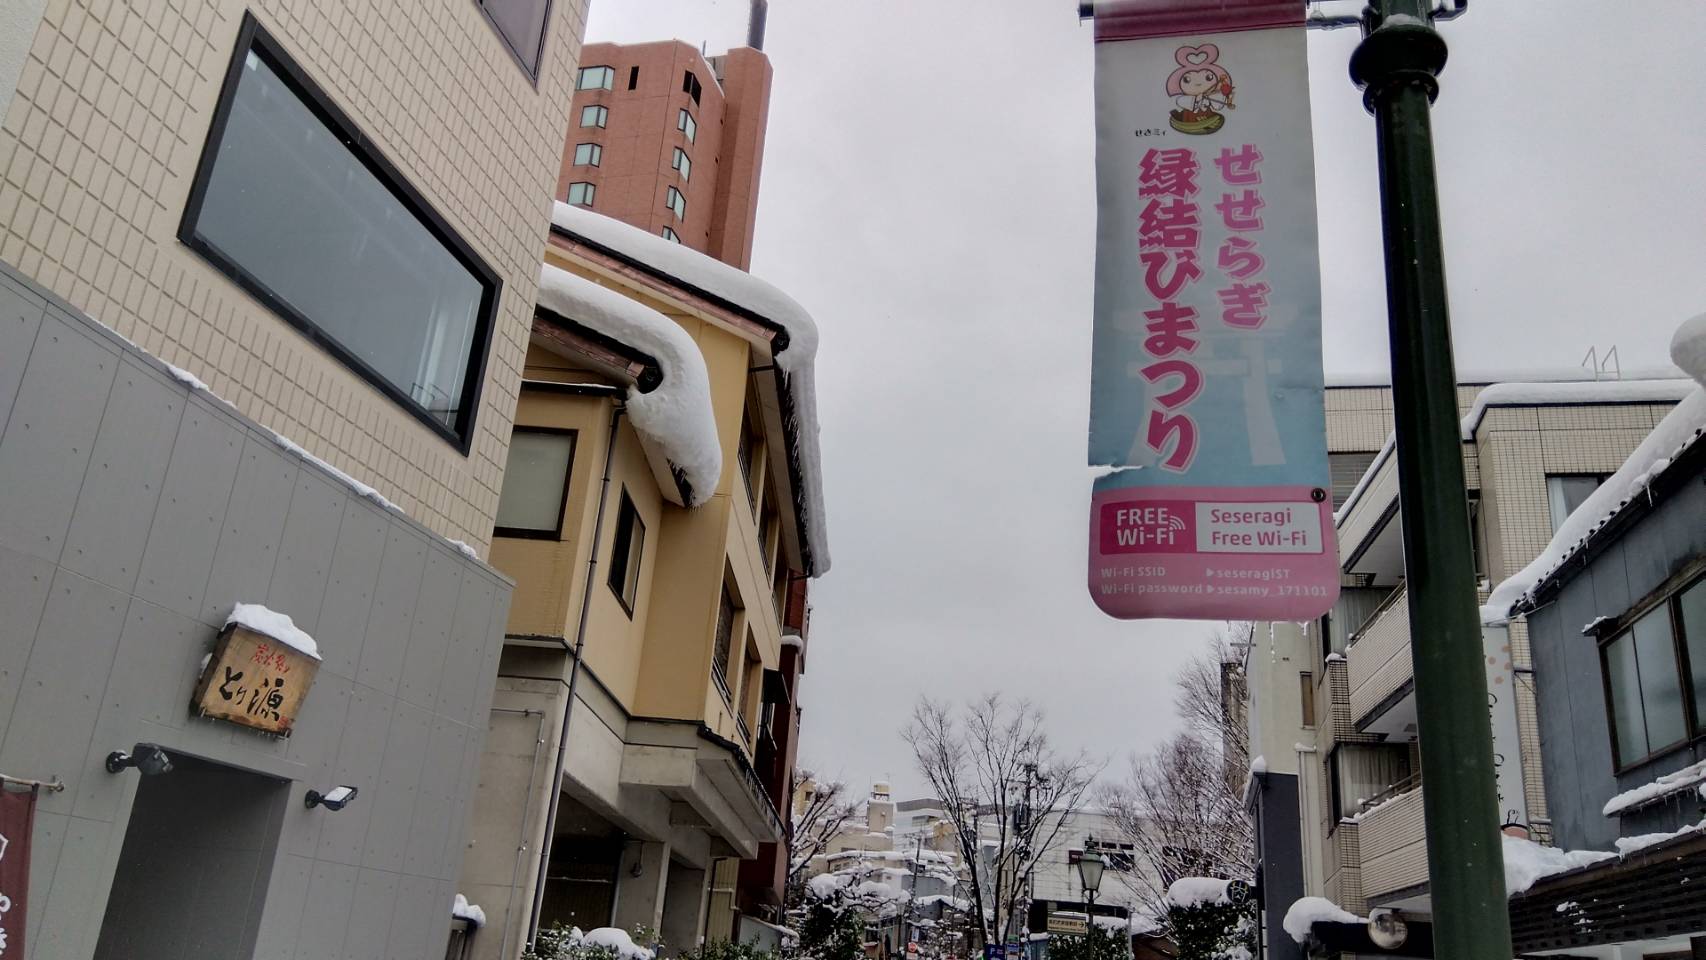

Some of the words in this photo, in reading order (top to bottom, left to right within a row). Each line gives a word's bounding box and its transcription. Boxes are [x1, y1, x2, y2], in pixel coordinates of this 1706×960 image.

[1214, 144, 1271, 329] せせらぎ
[1138, 148, 1204, 475] 縁結びまつり
[1117, 507, 1169, 526] FREE
[1210, 508, 1292, 527] Seseragi
[1117, 527, 1175, 546] Wi-Fi
[1212, 531, 1253, 546] Free
[1257, 531, 1307, 546] Wi-Fi
[1100, 567, 1135, 578] Wi-Fi
[1136, 567, 1167, 578] SSID
[1100, 583, 1135, 594] Wi-Fi
[1138, 583, 1203, 596] password
[1216, 584, 1328, 599] sesamy_171101
[218, 666, 285, 722] とり源
